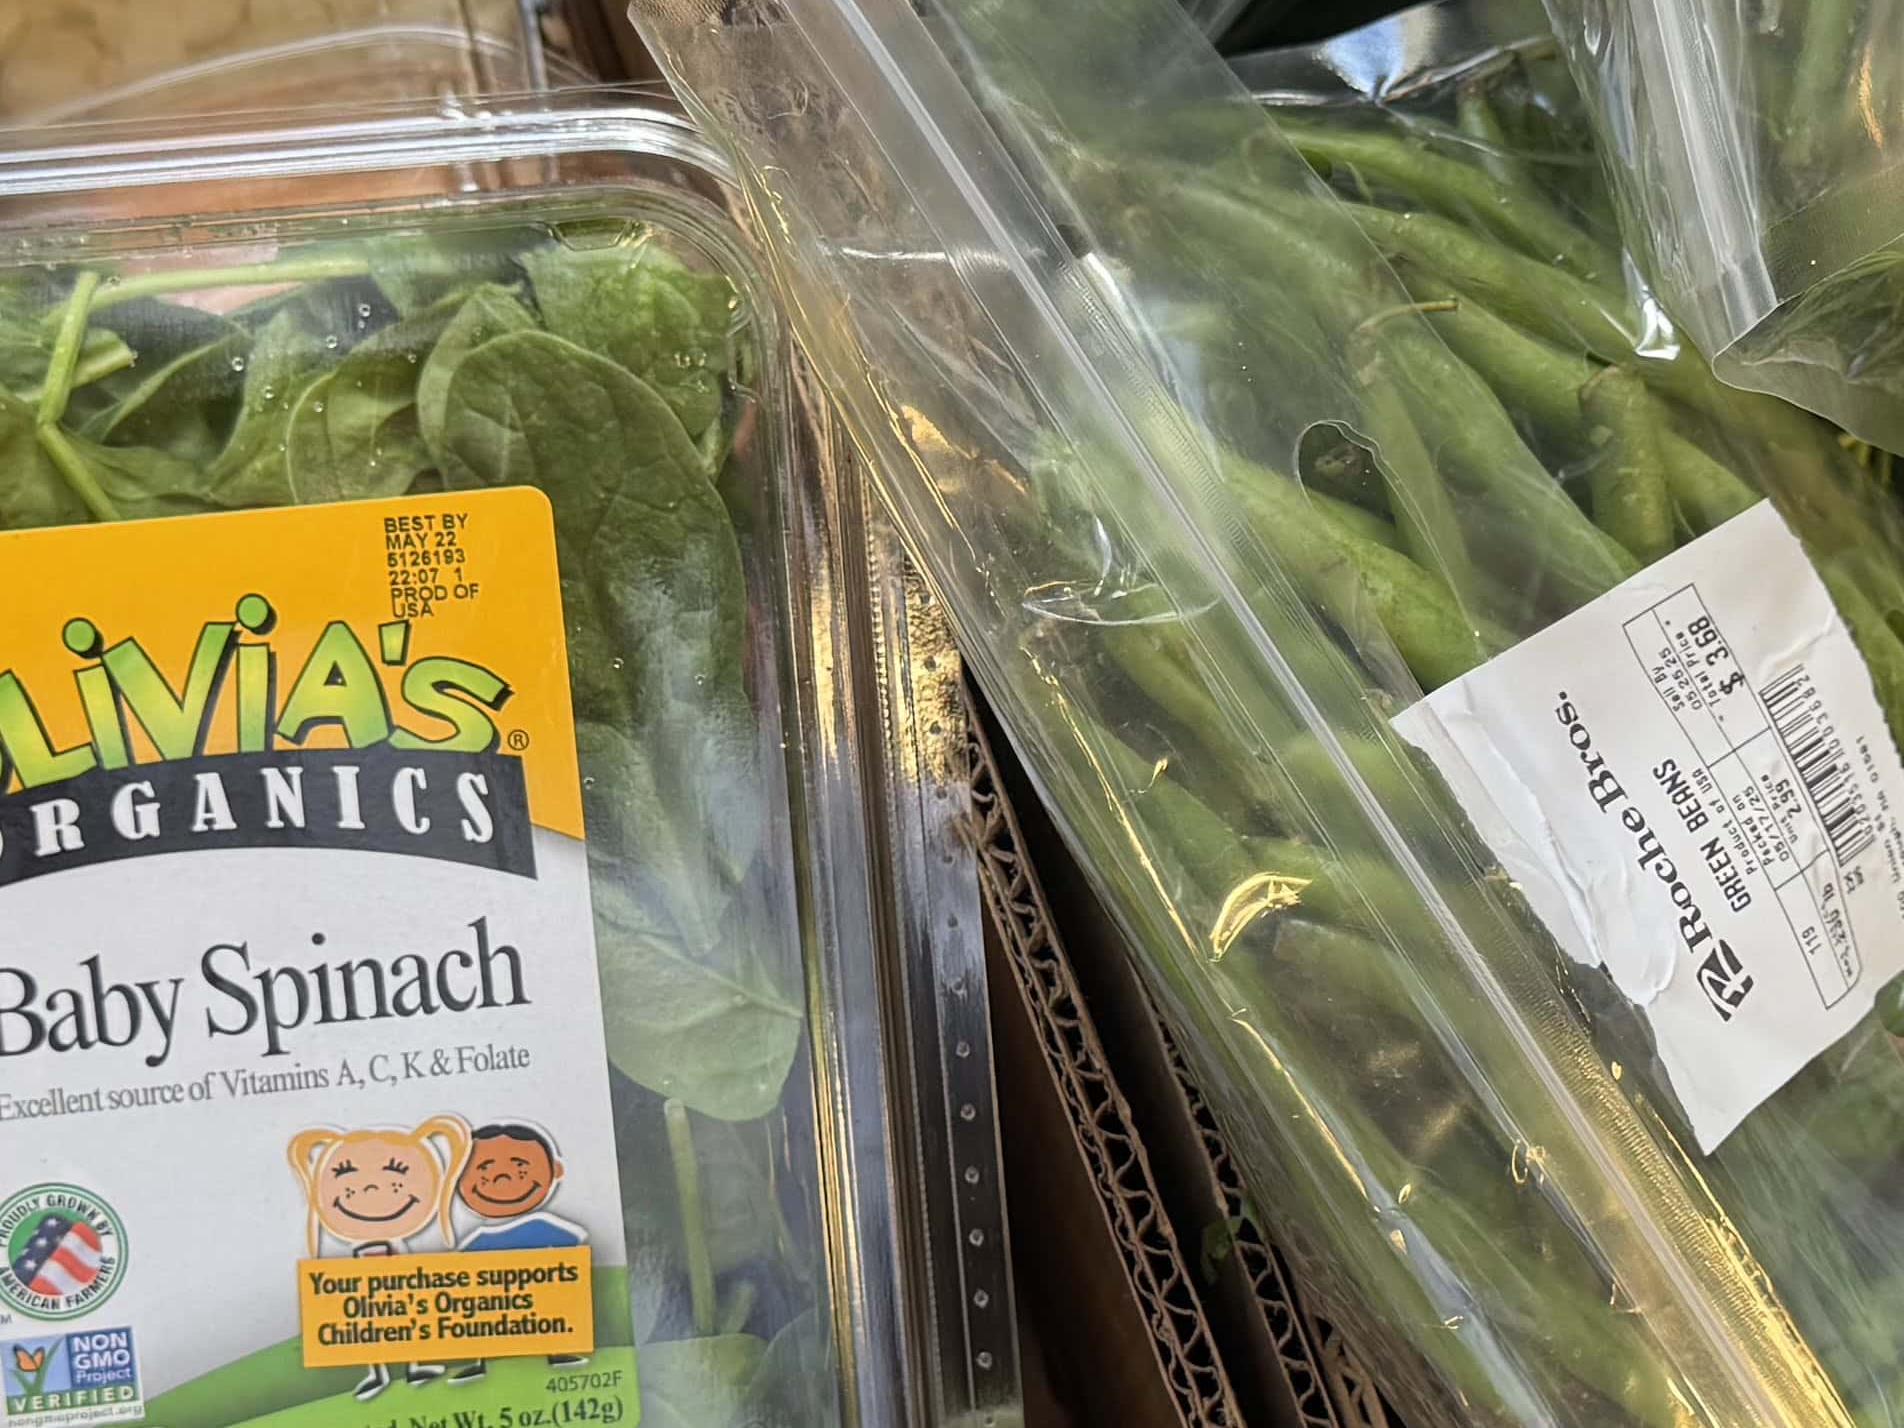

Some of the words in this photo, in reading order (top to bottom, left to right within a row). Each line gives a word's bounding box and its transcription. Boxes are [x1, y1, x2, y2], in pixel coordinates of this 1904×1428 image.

[384, 515, 435, 533] BEST
[442, 513, 468, 529] BY
[386, 533, 428, 550] MAY
[435, 531, 457, 547] 22
[387, 548, 466, 567] 5126193
[388, 567, 439, 586] 22:07
[454, 567, 463, 582] 1
[391, 585, 448, 602] PROD
[454, 583, 479, 599] OF
[392, 601, 434, 618] USA
[1675, 631, 1699, 668] Price
[1687, 615, 1729, 666] 3.68
[1651, 665, 1667, 683] By
[1658, 646, 1702, 709] 05.25.25
[1693, 670, 1720, 707] Total
[1718, 670, 1746, 694] $
[1662, 685, 1685, 715] Sell
[1555, 691, 1627, 812] Bros.
[1652, 758, 1708, 832] BEANS
[1691, 767, 1713, 793] USA
[1708, 798, 1725, 813] of
[1731, 793, 1746, 811] on
[1770, 778, 1802, 818] 2.99
[1743, 785, 1790, 861] 05/17/25
[1722, 818, 1757, 875] Product
[1739, 816, 1775, 866] Packed
[1621, 806, 1712, 952] Roche
[1700, 836, 1751, 911] GREEN
[1801, 925, 1822, 954] 119
[202, 916, 533, 1056] Spinach
[107, 1083, 186, 1110] source
[188, 1072, 221, 1102] of
[220, 1064, 329, 1098] Vitamins
[335, 1061, 367, 1092] A,
[368, 1056, 398, 1088] C,
[401, 1052, 427, 1082] K
[427, 1050, 453, 1078] &
[455, 1044, 532, 1076] Folate
[46, 1193, 101, 1221] GROWN
[95, 1218, 113, 1237] BY
[65, 1256, 115, 1308] FARMERS
[309, 1270, 360, 1295] Your
[368, 1267, 471, 1294] purchase
[476, 1262, 578, 1291] supports
[343, 1292, 428, 1319] Olivia's
[435, 1289, 533, 1318] Organics
[73, 1332, 128, 1352] NON
[318, 1318, 431, 1346] Children's
[438, 1312, 573, 1339] Foundation.
[74, 1349, 130, 1369] GMO
[76, 1367, 132, 1384] Project
[545, 1370, 623, 1394] 405702F
[14, 1385, 134, 1412] VERIFIED
[8, 1403, 143, 1428] nongmoproject.org
[500, 1407, 513, 1423] 5
